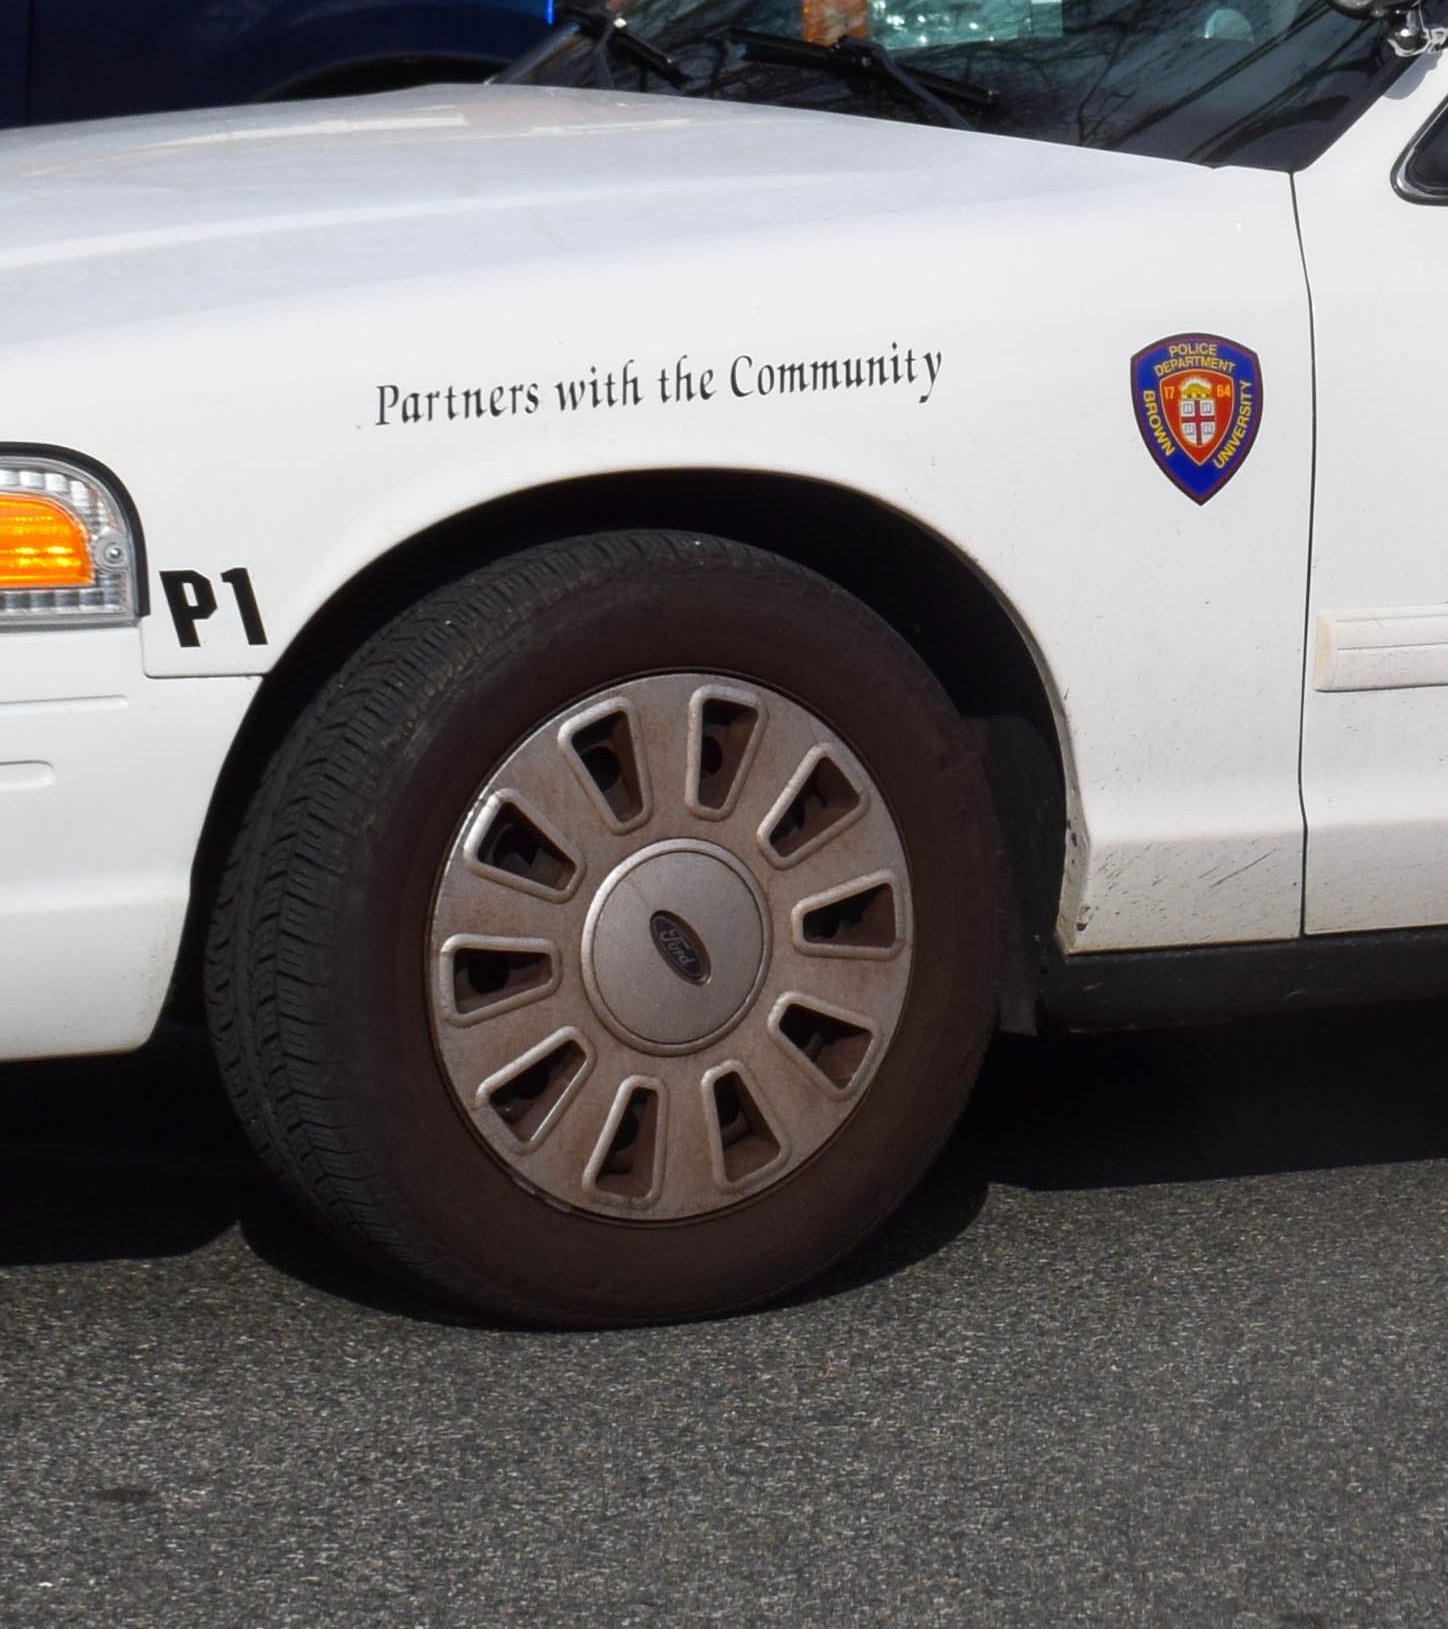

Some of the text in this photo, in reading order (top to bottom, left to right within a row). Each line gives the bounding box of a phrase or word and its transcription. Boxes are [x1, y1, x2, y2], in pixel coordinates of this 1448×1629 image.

[375, 342, 942, 426] Partners with the Community
[1154, 356, 1236, 377] DEPARTMENT
[1169, 342, 1217, 357] POLICE
[1143, 390, 1175, 457] BROWN
[1212, 379, 1253, 469] UNIVERSITY
[159, 567, 268, 648] P1
